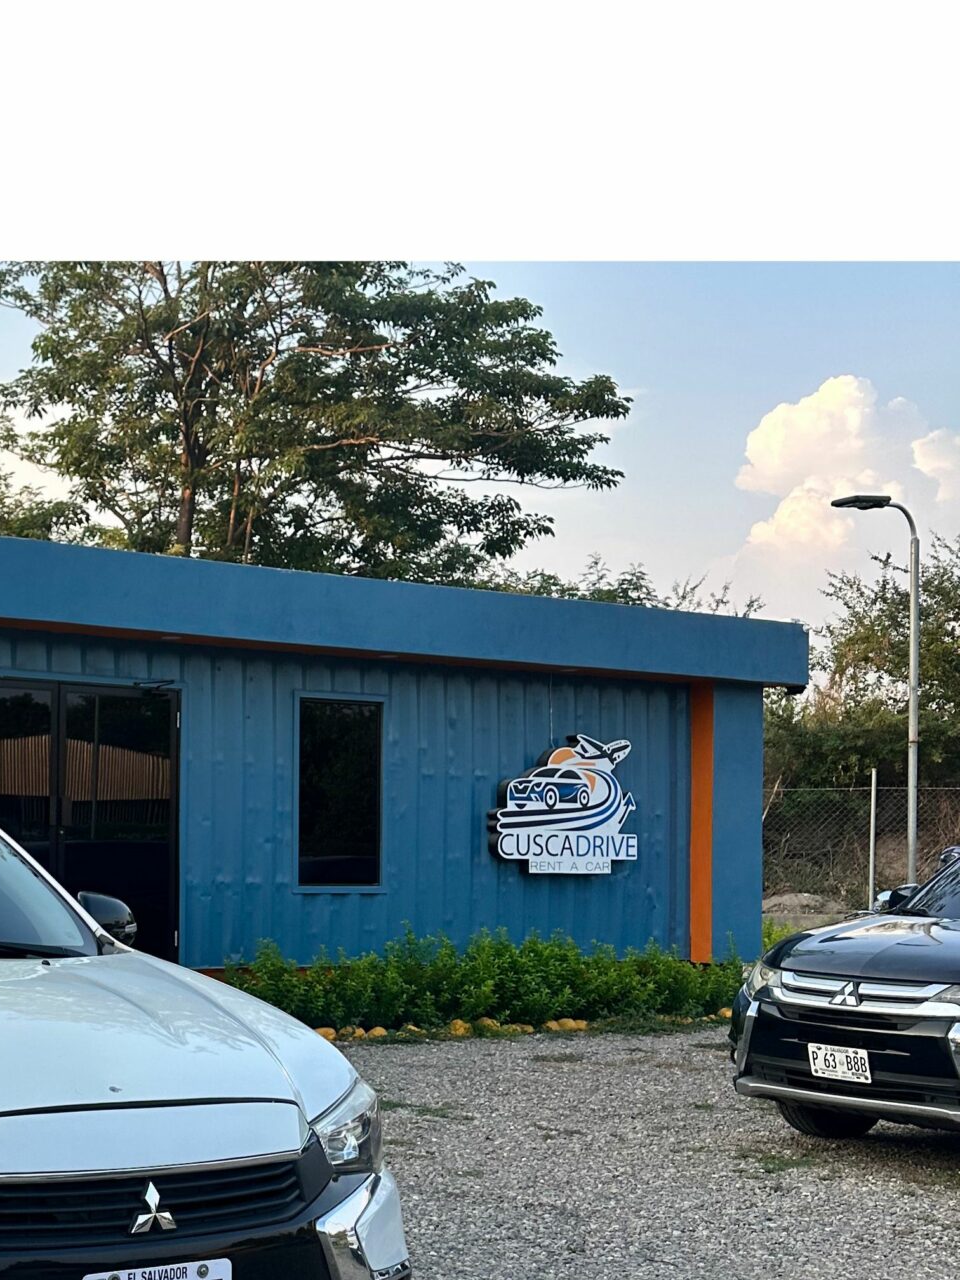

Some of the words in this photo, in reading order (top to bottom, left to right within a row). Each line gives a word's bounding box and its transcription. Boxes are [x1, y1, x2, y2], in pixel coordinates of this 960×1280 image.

[499, 833, 636, 858] CUSCADRIVE
[530, 861, 563, 872] RENT
[570, 861, 579, 872] A
[585, 861, 610, 872] CAR
[812, 1050, 818, 1067] P
[823, 1052, 837, 1069] 63
[845, 1054, 868, 1073] B8B
